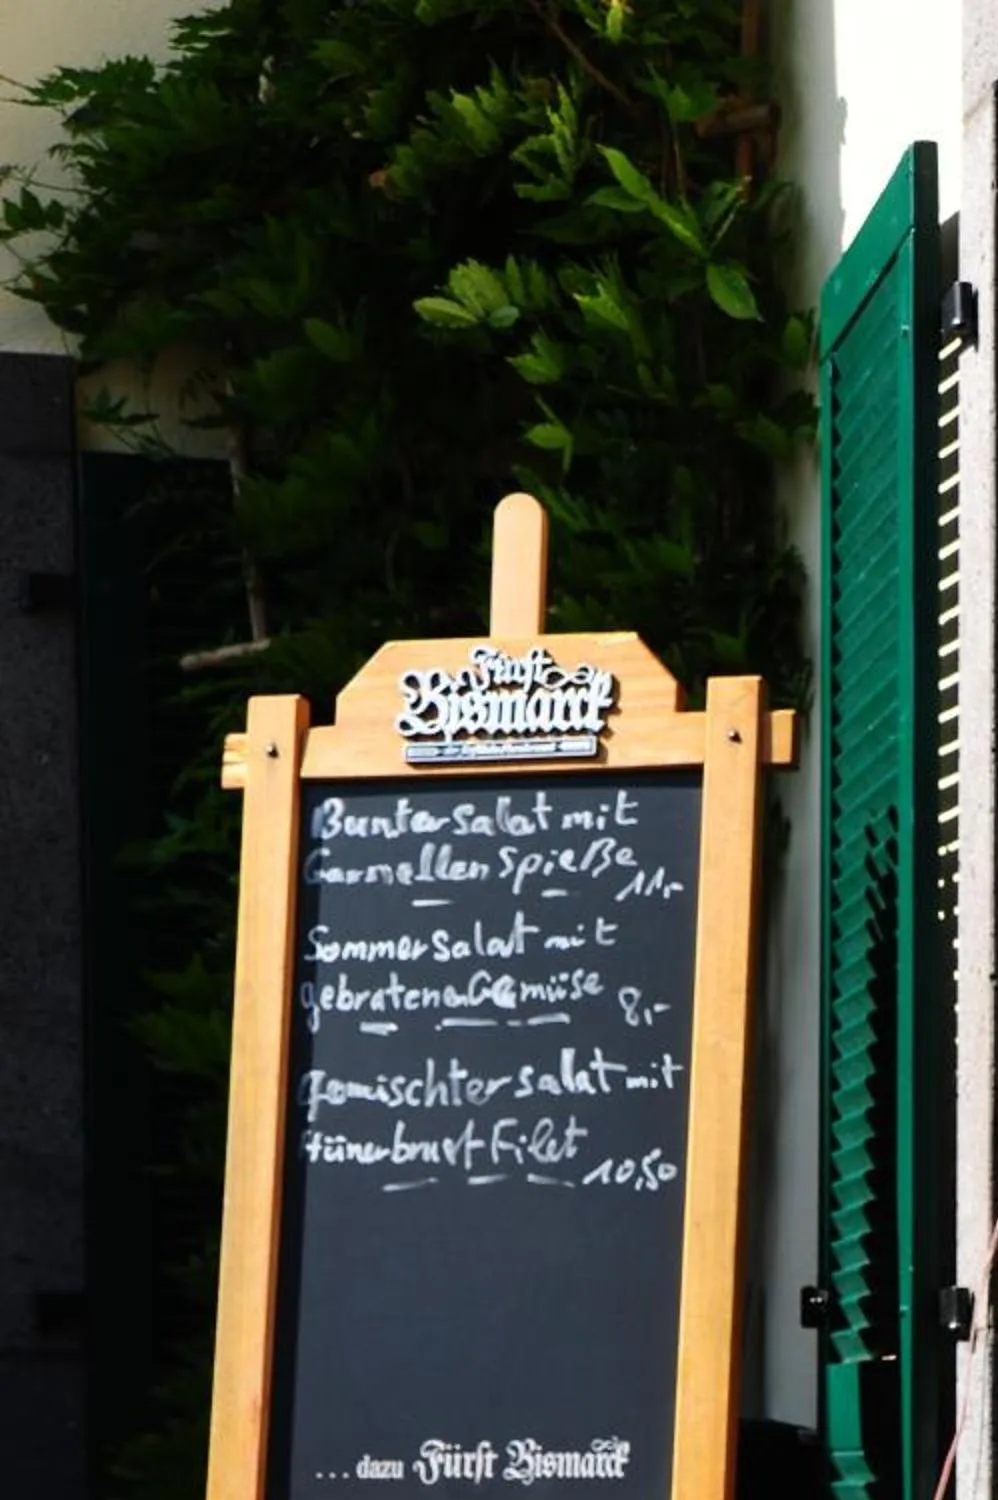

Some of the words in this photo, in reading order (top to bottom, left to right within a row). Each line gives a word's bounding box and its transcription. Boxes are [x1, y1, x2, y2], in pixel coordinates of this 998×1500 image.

[562, 790, 639, 830] mit
[304, 924, 429, 963] Sommer
[431, 911, 540, 963] Salat
[544, 917, 618, 948] mit
[626, 1053, 684, 1090] mit
[491, 1115, 588, 1165] Filet
[582, 1148, 679, 1191] 10,50
[356, 1453, 404, 1479] dazu
[412, 1438, 498, 1485] Fürst
[502, 1436, 631, 1486] Bismarck
